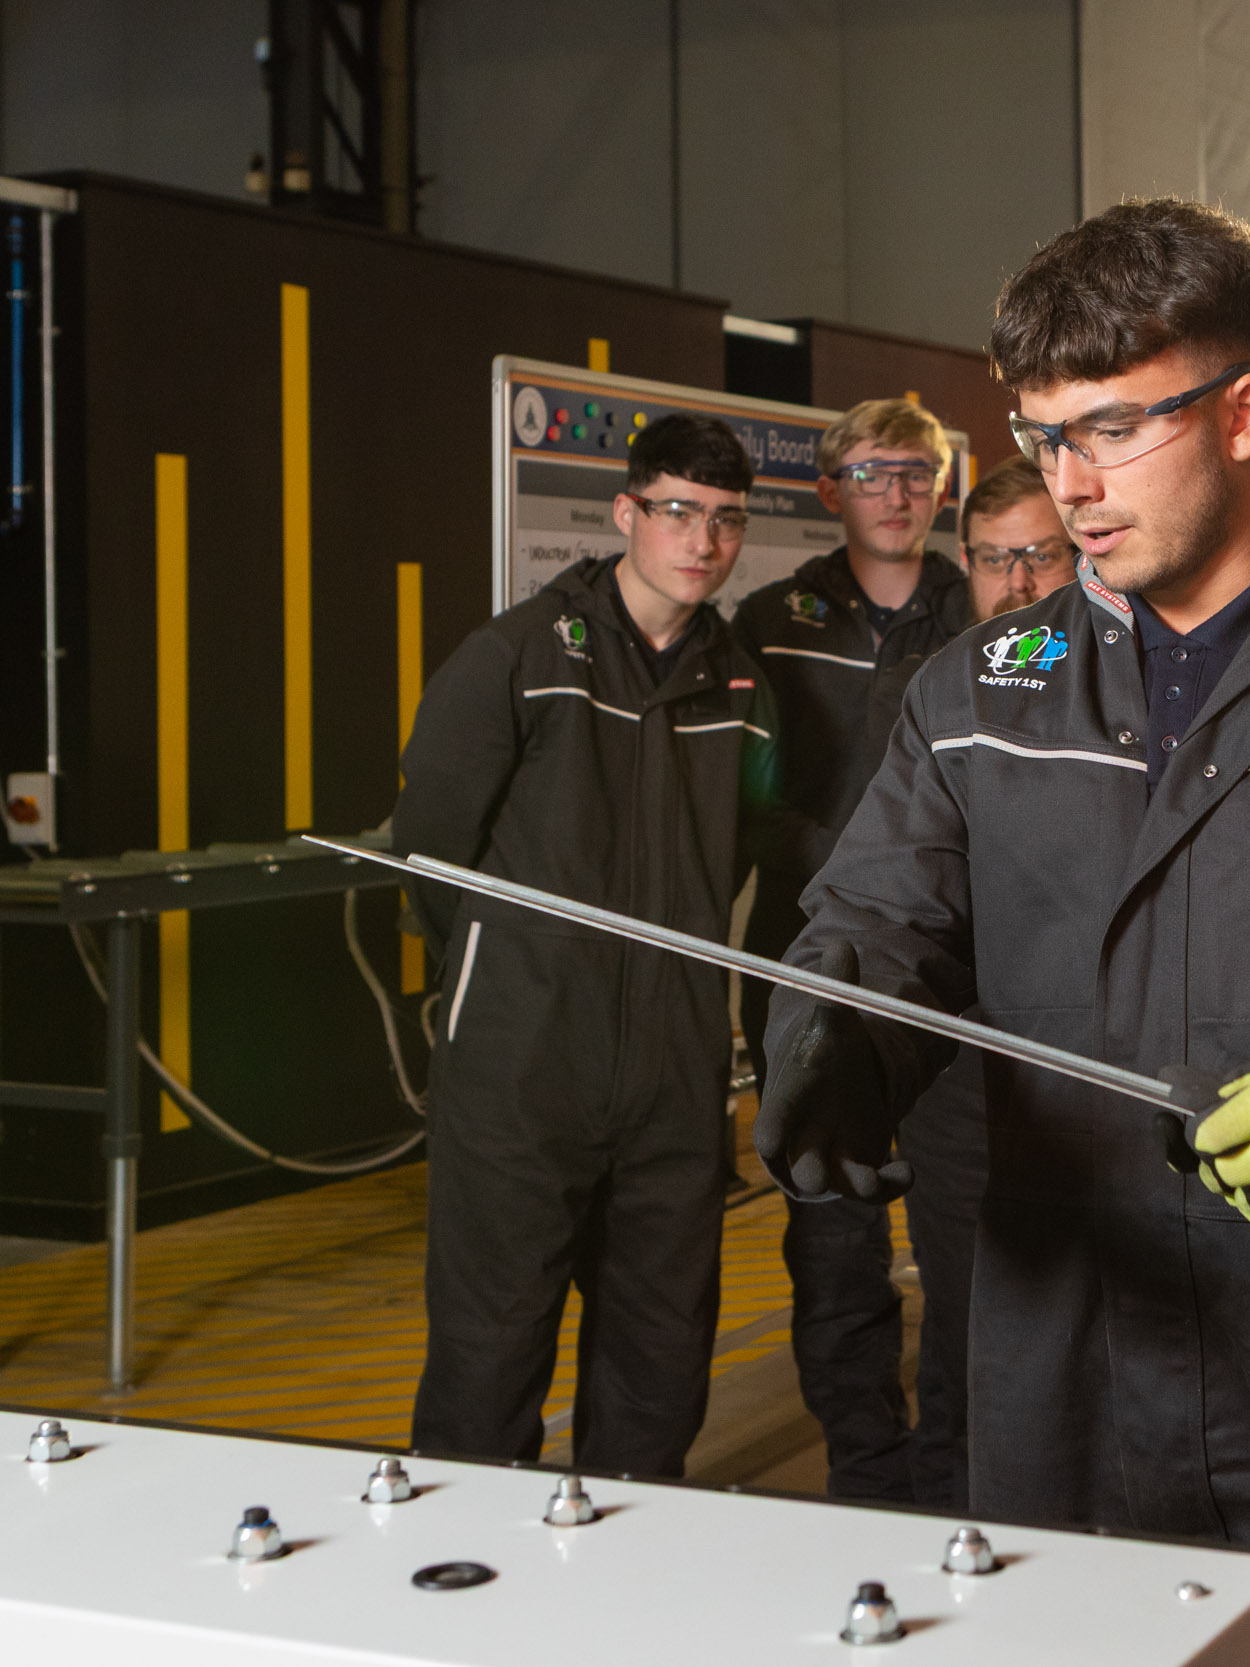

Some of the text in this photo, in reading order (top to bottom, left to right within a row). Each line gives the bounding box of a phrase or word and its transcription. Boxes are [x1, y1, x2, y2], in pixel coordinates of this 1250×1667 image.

[737, 425, 815, 470] ily Board
[1087, 582, 1129, 611] BAE SYSTEMS
[978, 674, 1047, 691] SAFETY 1ST
